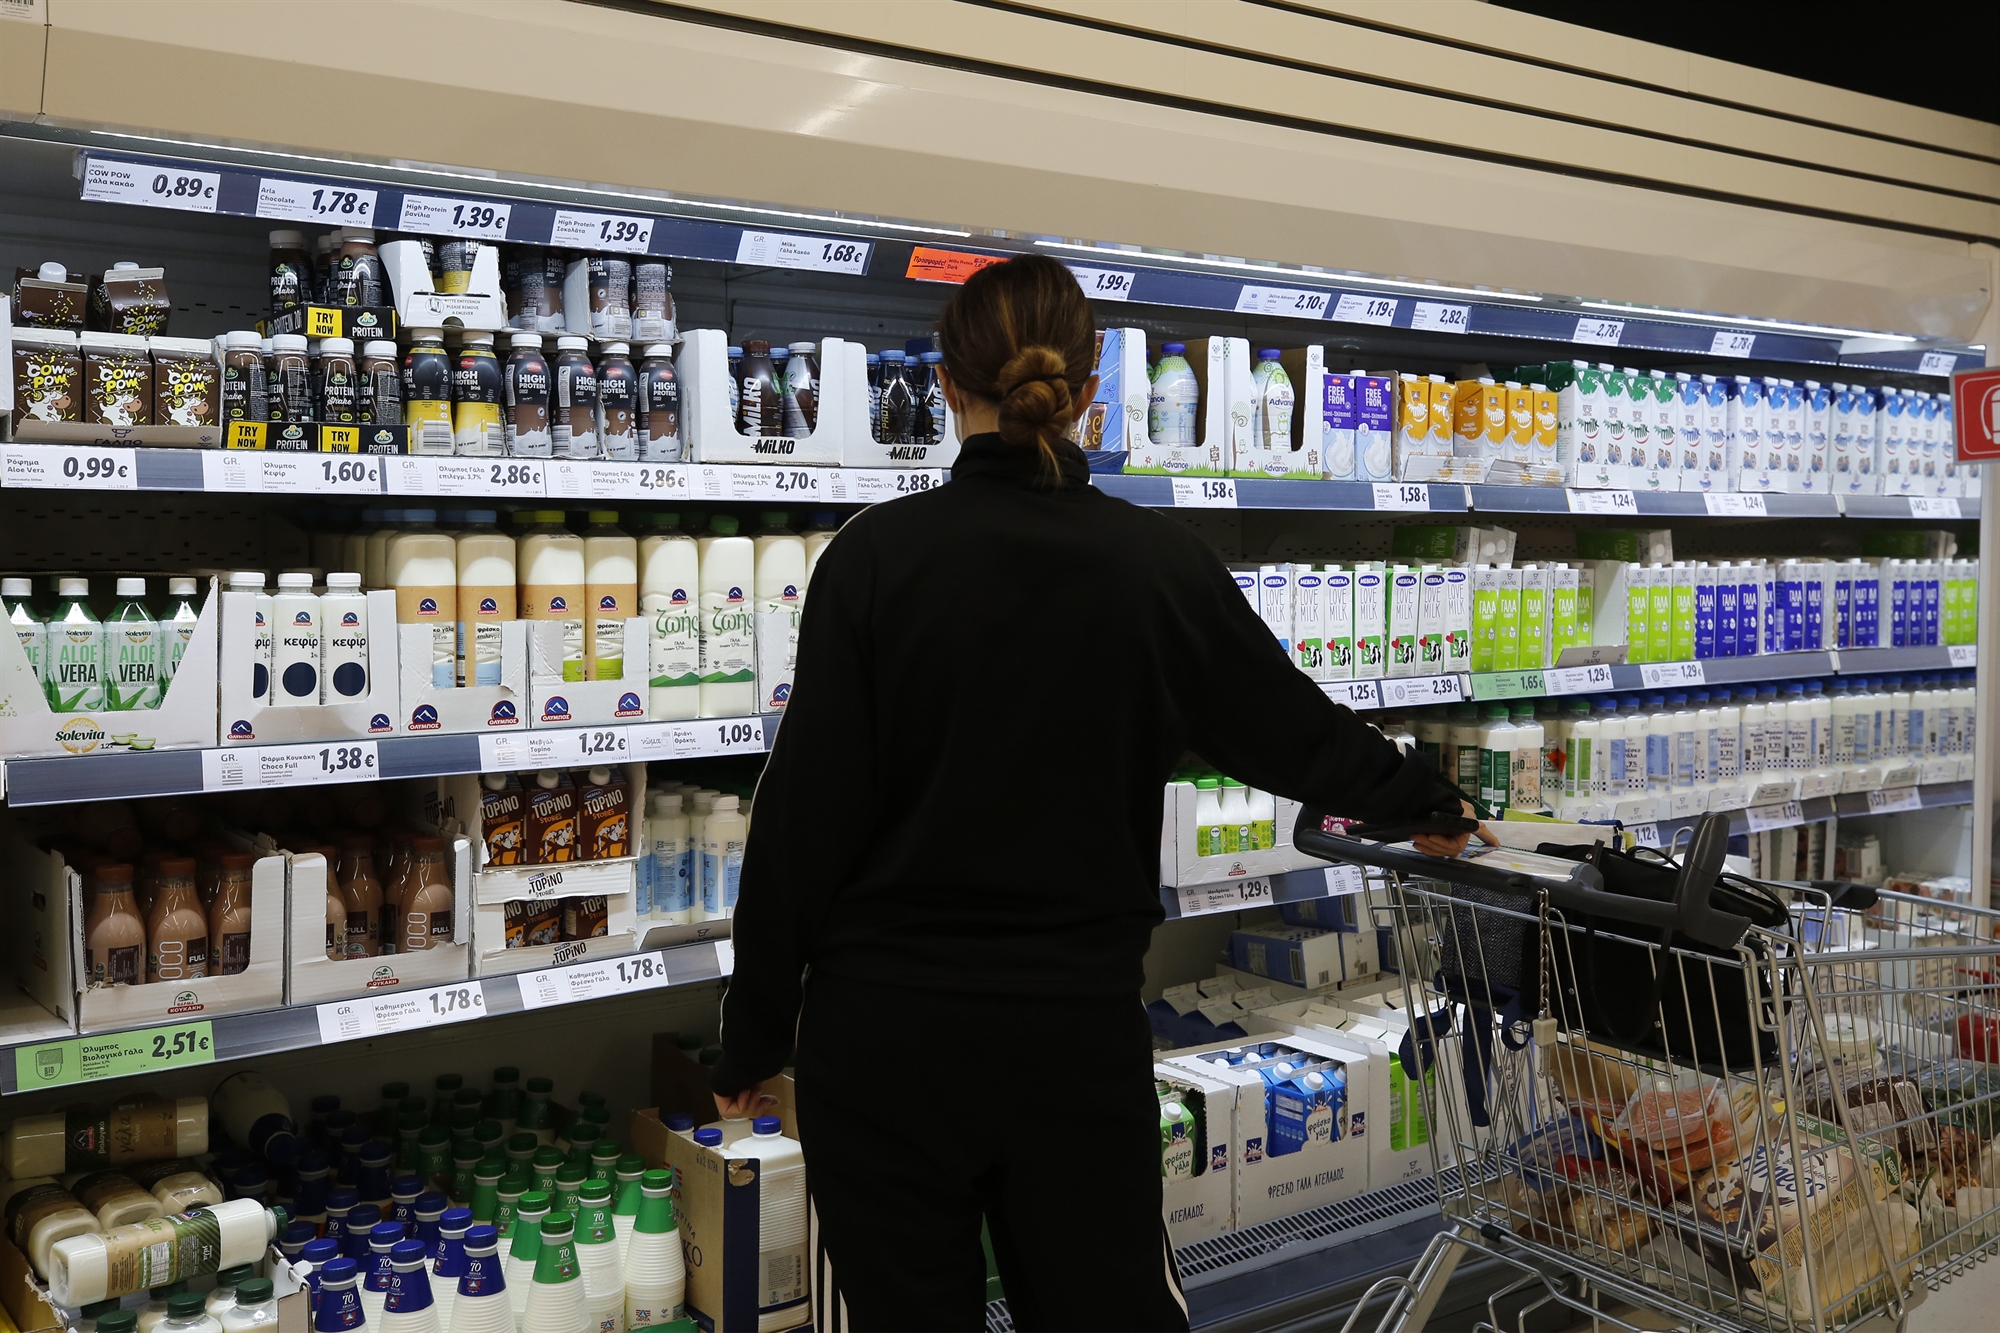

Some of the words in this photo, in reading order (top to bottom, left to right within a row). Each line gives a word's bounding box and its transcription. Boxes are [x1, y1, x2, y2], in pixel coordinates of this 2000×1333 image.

[89, 169, 110, 178] COW
[110, 171, 131, 179] POW
[88, 178, 107, 187] γάλα
[109, 180, 135, 188] κακάο
[152, 174, 215, 199] 0,89€
[261, 187, 276, 195] Arla
[260, 195, 296, 204] Chocolate
[311, 189, 370, 215] 1,78€
[406, 204, 422, 213] High
[422, 205, 448, 214] Protein
[452, 204, 506, 230] 1,39€
[558, 219, 573, 228] High
[573, 221, 596, 229] Protein
[600, 219, 649, 244] 1,39€
[822, 242, 863, 264] 1,68€
[1096, 273, 1130, 292] 1,99€
[1295, 294, 1325, 311] 2,10€
[1366, 300, 1394, 318] 1,19€
[316, 312, 334, 324] TRY
[1440, 308, 1467, 326] 2,82€
[316, 324, 334, 335] NOW
[352, 327, 383, 338] PROTEIN
[1596, 324, 1621, 339] 2,78€
[26, 362, 65, 379] COW
[99, 366, 136, 382] COW
[33, 374, 68, 389] POW
[519, 374, 546, 384] HIGH
[600, 380, 626, 389] HIGH
[519, 382, 546, 390] PROTEIN
[654, 382, 677, 391] HIGH
[1328, 386, 1345, 397] FREE
[1366, 388, 1382, 399] FREE
[1328, 396, 1345, 405] FROM
[1366, 398, 1382, 407] FROM
[238, 426, 259, 437] TRY
[331, 431, 351, 442] TRY
[237, 438, 257, 448] NOW
[276, 440, 308, 450] PROTEIN
[331, 443, 350, 453] NOW
[7, 458, 40, 468] Ρόφημα
[223, 457, 241, 466] GR.
[264, 462, 297, 472] Όλυμπος
[1162, 460, 1189, 470] Advance
[7, 466, 26, 474] Aloe
[63, 457, 129, 481] 0,99€
[264, 470, 287, 478] Κεφίρ
[322, 460, 378, 485] 1,60€
[438, 465, 468, 474] Όλυμπος
[560, 466, 575, 474] GR.
[592, 470, 620, 479] Όλυμπος
[1264, 464, 1289, 473] Advance
[467, 474, 482, 482] 3,7%
[490, 464, 541, 487] 2,86€
[776, 471, 818, 492] 2,70€
[1202, 482, 1234, 500] 1,58€
[1400, 486, 1427, 504] 1,58€
[1266, 588, 1285, 606] LOVE
[1300, 588, 1319, 606] LOVE
[1329, 588, 1348, 606] LOVE
[1360, 588, 1378, 605] LOVE
[1397, 588, 1413, 605] LOVE
[1267, 606, 1286, 622] MILK
[1300, 606, 1320, 622] MILK
[1330, 606, 1348, 621] MILK
[1360, 606, 1378, 620] MILK
[1397, 605, 1413, 620] MILK
[656, 608, 699, 640] ζωής
[712, 606, 753, 636] ζωής
[60, 645, 98, 664] ALOE
[120, 645, 155, 664] ALOE
[60, 664, 97, 683] VERA
[119, 664, 155, 683] VERA
[1587, 667, 1610, 684] 1,29€
[1432, 679, 1459, 696] 2,39€
[1520, 676, 1544, 691] 1,65€
[1348, 684, 1376, 702] 1,25€
[489, 718, 518, 726] ΟΛΥΜΠΟΣ
[542, 714, 571, 722] ΟΛΥΜΠΟΣ
[55, 730, 106, 742] Solevita
[718, 724, 762, 747] 1,09€
[496, 738, 511, 746] GR.
[530, 738, 554, 747] Μεβγάλ
[578, 732, 626, 756] 1,22€
[220, 754, 238, 763] GR.
[261, 756, 285, 764] Φάρμα
[286, 754, 316, 762] Κουκάκη
[319, 747, 375, 774] 1,38€
[284, 762, 299, 770] Full
[1238, 880, 1269, 901] 1,29€
[432, 926, 450, 934] FULL
[188, 954, 206, 964] FULL
[569, 970, 605, 980] Καθημερινά
[617, 958, 664, 983] 1,78€
[536, 974, 550, 983] GR.
[571, 978, 596, 987] Φρέσκο
[375, 1000, 416, 1012] Καθημερινά
[428, 988, 483, 1016] 1,78€
[169, 1005, 202, 1014] ΚΟΥΚΑΚΗ
[338, 1006, 354, 1015] GR.
[376, 1010, 404, 1019] Φρέσκο
[404, 1008, 421, 1016] Γάλα
[82, 1043, 120, 1054] Όλυμπος
[152, 1030, 209, 1060] 2,51€
[82, 1052, 123, 1062] Βιολογικό
[124, 1048, 144, 1056] Γάλα
[1308, 1118, 1332, 1134] φρέσκο
[1314, 1128, 1330, 1140] γάλα
[1164, 1150, 1192, 1168] φρέσκο
[1173, 1160, 1190, 1175] γάλα
[1402, 1168, 1422, 1178] ΓΑΛΠΟ
[1268, 1181, 1294, 1199] ΦΡΕΣΚΟ
[1296, 1175, 1312, 1190] ΓΑΛΑ
[1314, 1168, 1345, 1187] ΑΓΕΛΑΔΟΣ
[594, 1212, 605, 1222] 70
[1170, 1204, 1204, 1224] ΑΓΕΛΑΔΟΣ
[559, 1248, 570, 1258] 70
[470, 1262, 482, 1273] 70
[342, 1294, 354, 1304] 70
